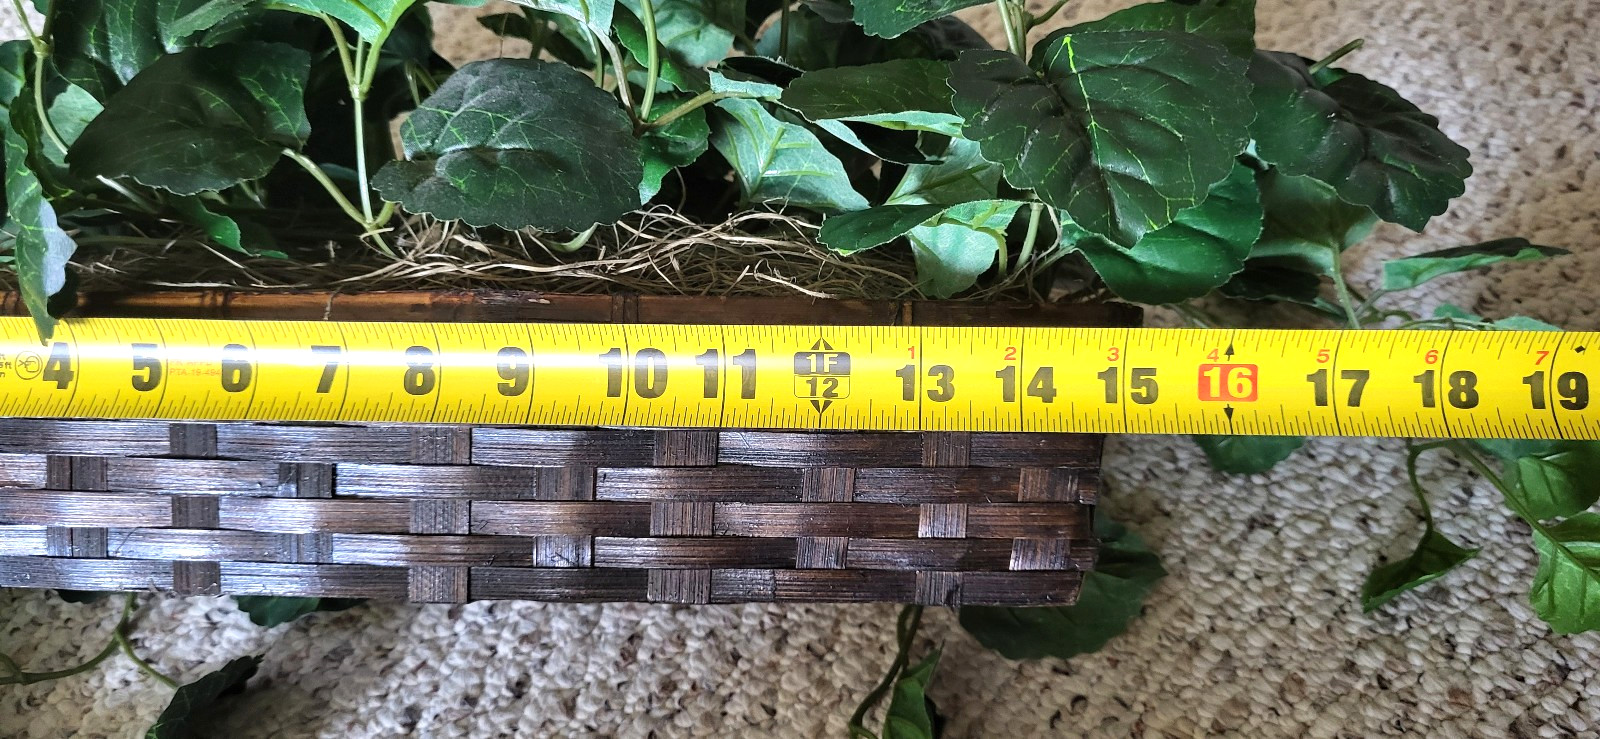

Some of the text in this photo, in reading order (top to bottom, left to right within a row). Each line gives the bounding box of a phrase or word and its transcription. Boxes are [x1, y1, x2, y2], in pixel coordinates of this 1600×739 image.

[42, 341, 74, 390] 4
[131, 343, 162, 392] 5
[221, 343, 252, 393] 6
[311, 345, 341, 393] 7
[403, 346, 436, 396] 8
[497, 346, 530, 397] 9
[806, 353, 838, 373] 1F
[908, 345, 916, 360] 1
[1004, 346, 1017, 361] 2
[1106, 347, 1120, 362] 3
[1206, 348, 1220, 362] 4
[1316, 349, 1331, 364] 5
[1424, 349, 1439, 365] 6
[1534, 350, 1550, 366] 7
[599, 347, 668, 399] 10
[695, 348, 757, 400] 11
[806, 378, 839, 398] 12
[895, 364, 955, 402] 13
[995, 365, 1057, 403] 14
[1097, 366, 1159, 404] 15
[1203, 366, 1253, 399] 16
[1306, 368, 1371, 408] 17
[1413, 369, 1480, 410] 18
[1522, 370, 1590, 411] 19
